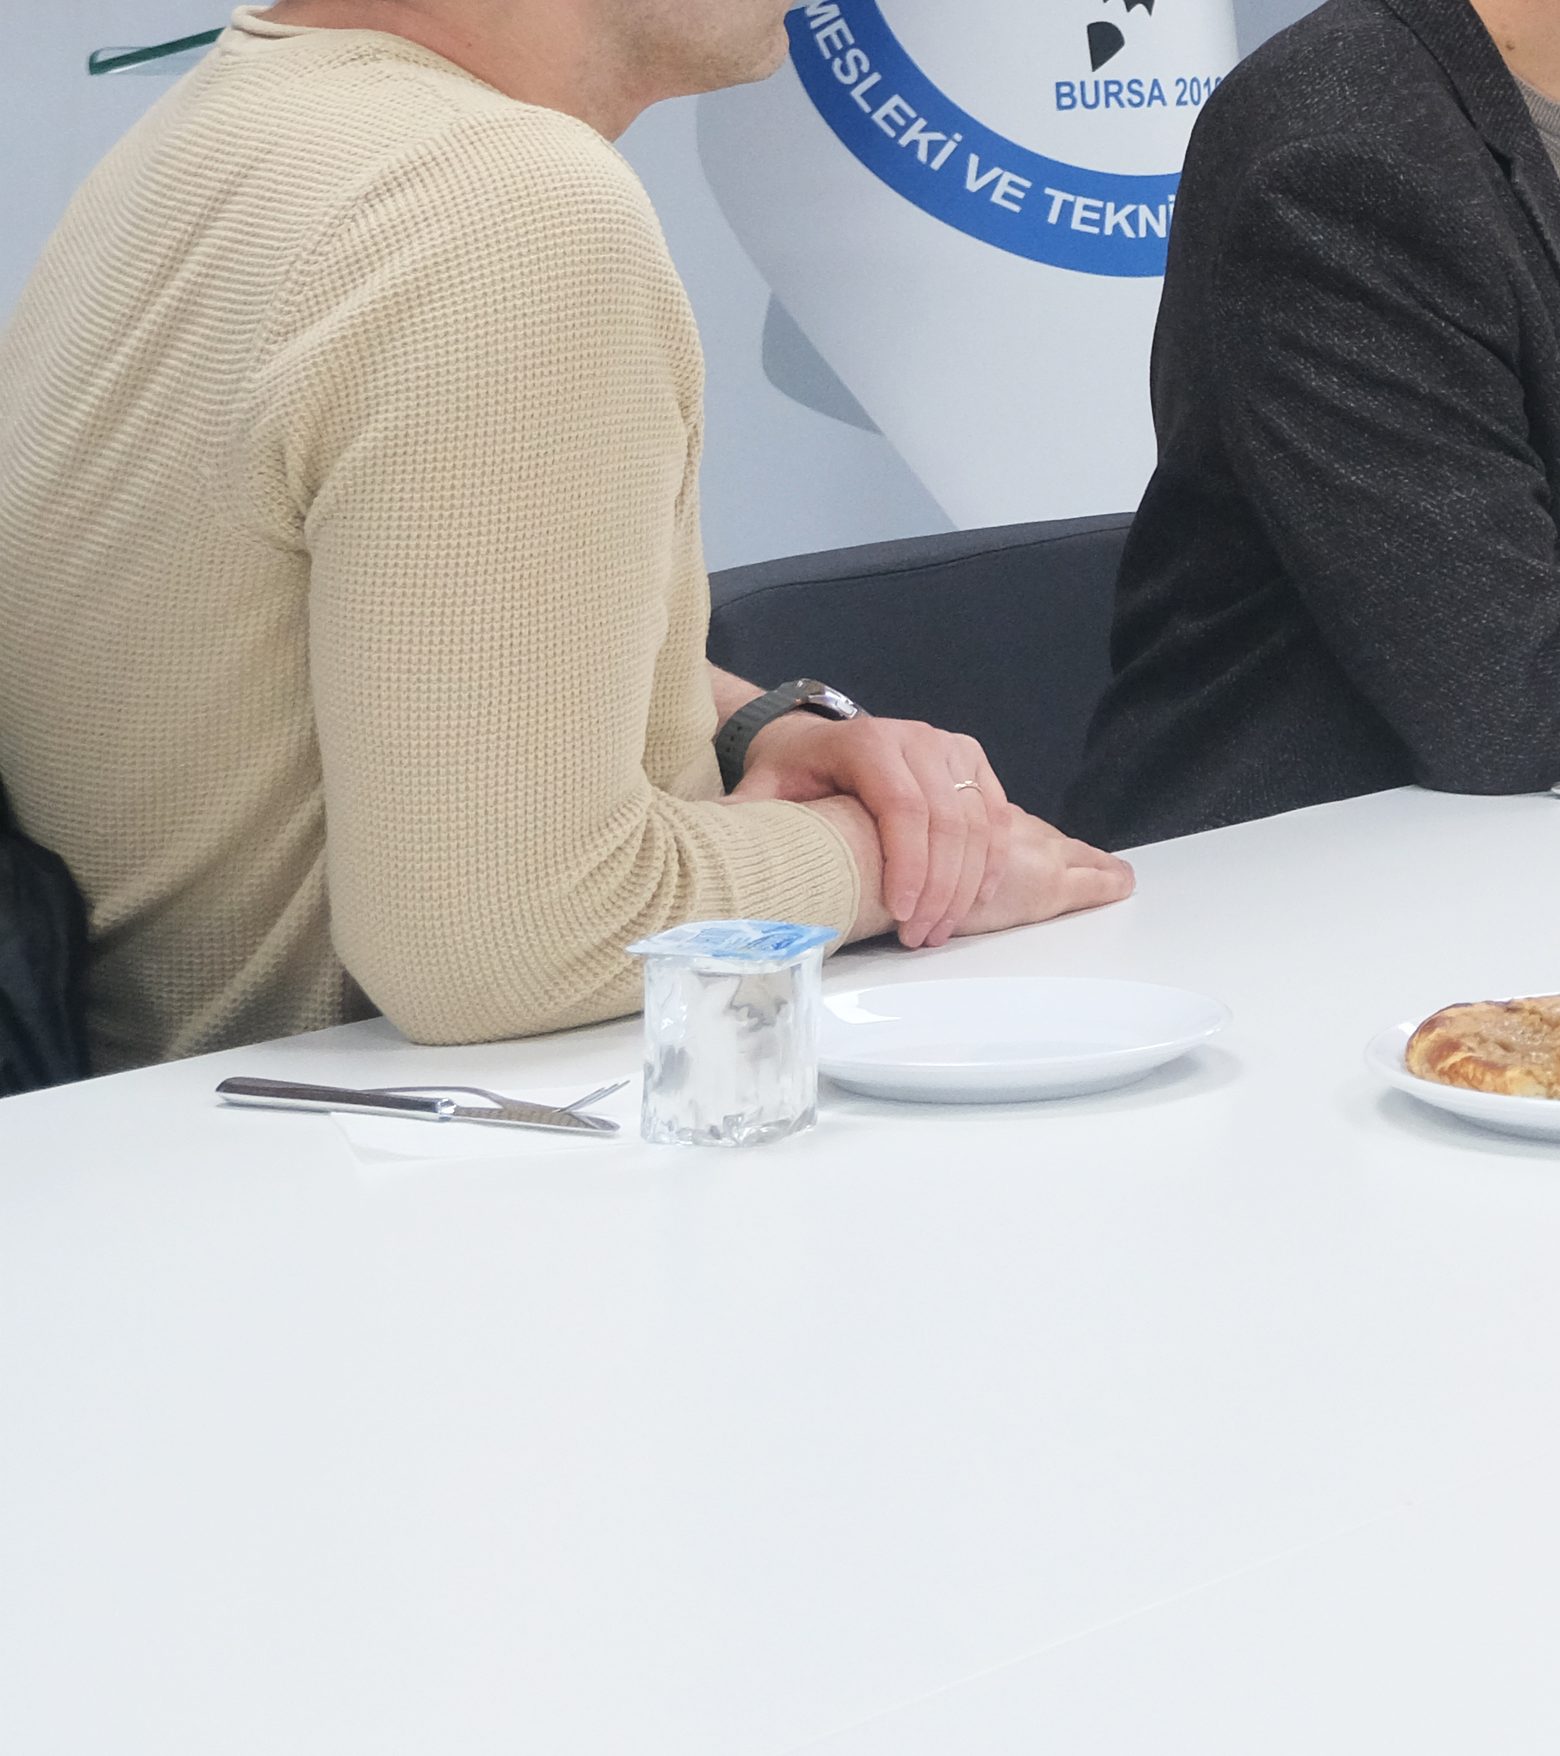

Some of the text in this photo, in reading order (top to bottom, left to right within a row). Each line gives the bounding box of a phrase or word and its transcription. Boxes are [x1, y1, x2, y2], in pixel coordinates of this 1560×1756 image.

[804, 0, 964, 172] MESLEKİ
[965, 152, 1032, 213] VE
[1055, 78, 1167, 111] BURSA
